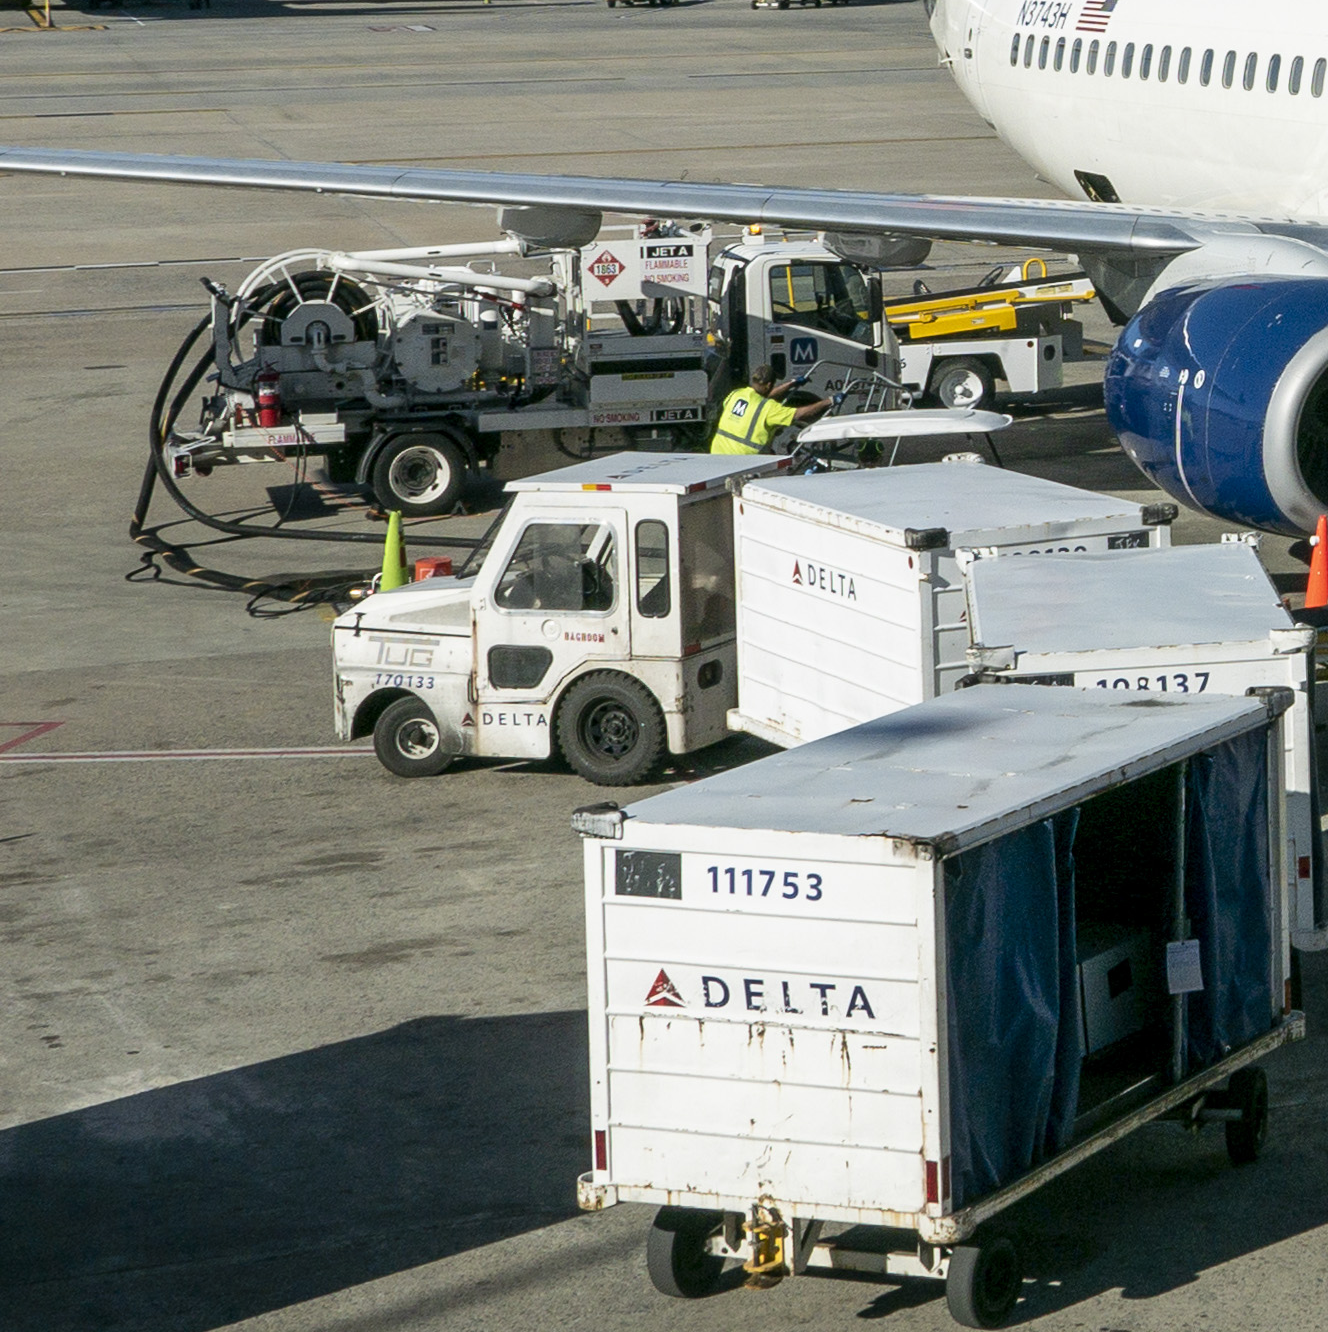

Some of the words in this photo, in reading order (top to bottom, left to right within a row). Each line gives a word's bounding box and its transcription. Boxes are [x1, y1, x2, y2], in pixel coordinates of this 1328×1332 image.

[1016, 0, 1073, 30] N3743H
[652, 246, 676, 257] JET
[677, 246, 689, 256] A
[596, 263, 617, 275] 1863
[645, 259, 689, 270] FLAMMABLE
[644, 274, 655, 283] NO
[656, 273, 690, 284] SMOKING
[593, 414, 605, 424] NO
[606, 412, 640, 423] SMOKING
[661, 410, 681, 421] JET
[683, 409, 693, 419] A
[807, 563, 857, 601] DELTA
[368, 635, 440, 667] TUG
[376, 673, 435, 689] 170133
[483, 712, 548, 727] DELTA
[707, 866, 823, 901] 111753
[702, 975, 876, 1019] DELTA
